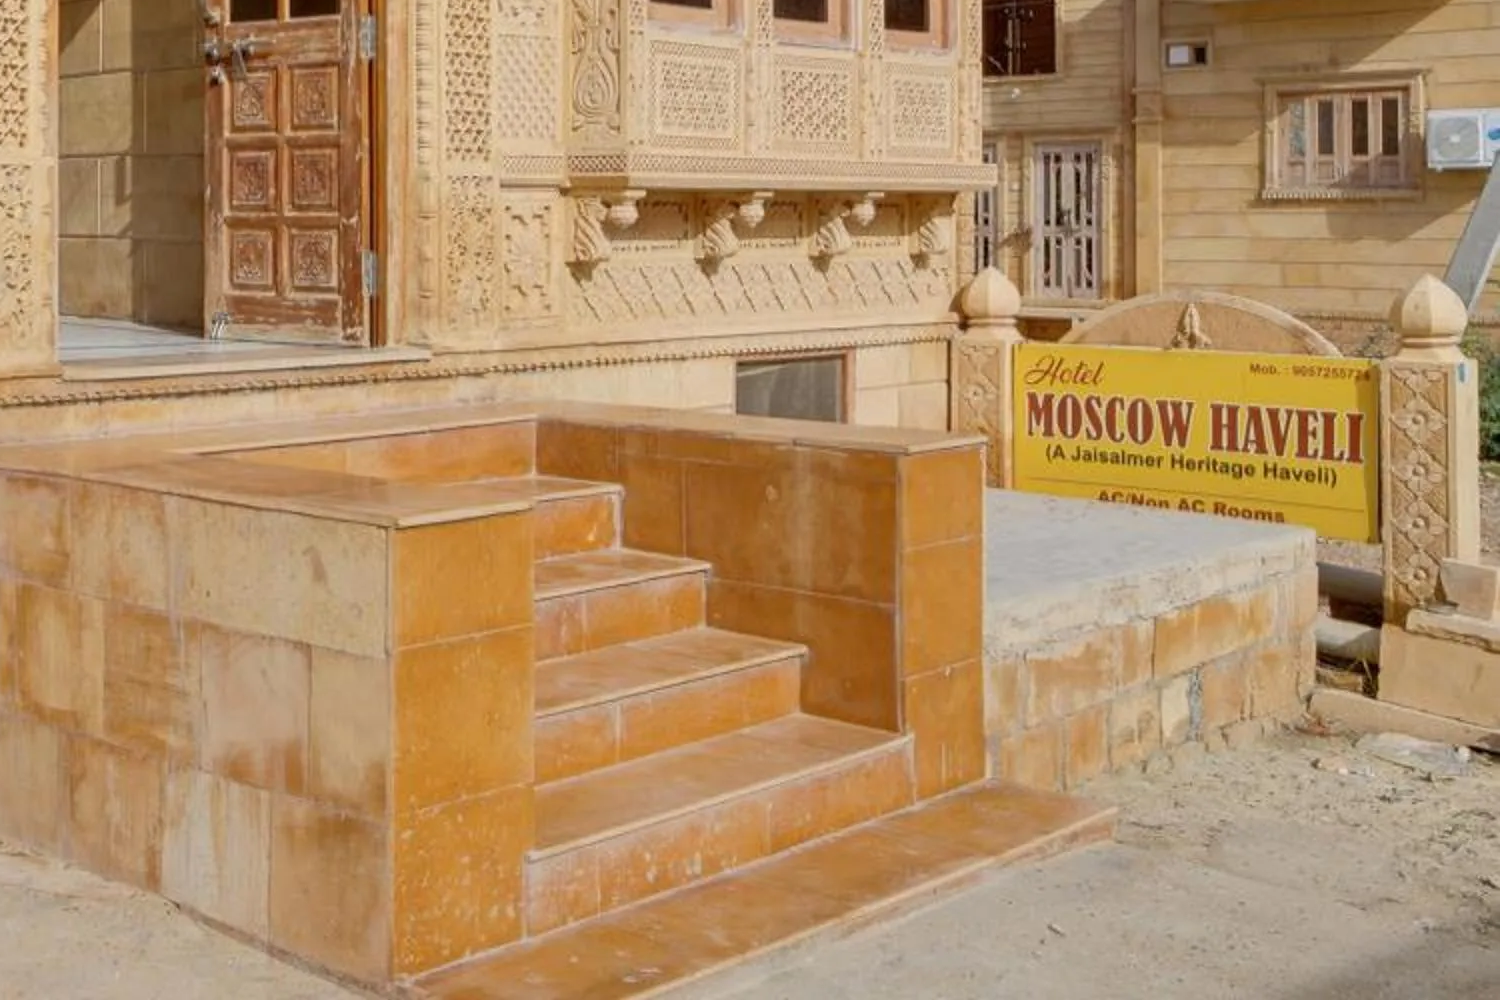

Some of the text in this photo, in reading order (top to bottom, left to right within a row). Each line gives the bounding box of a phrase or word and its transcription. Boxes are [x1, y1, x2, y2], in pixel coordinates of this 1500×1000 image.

[1024, 355, 1105, 387] Hotel
[1026, 391, 1365, 464] MOSCOW HAVELI
[1045, 443, 1338, 489] (A Jaisalmer Heritage Haveli)
[1177, 497, 1205, 514] AC
[1212, 501, 1286, 524] Rooms
